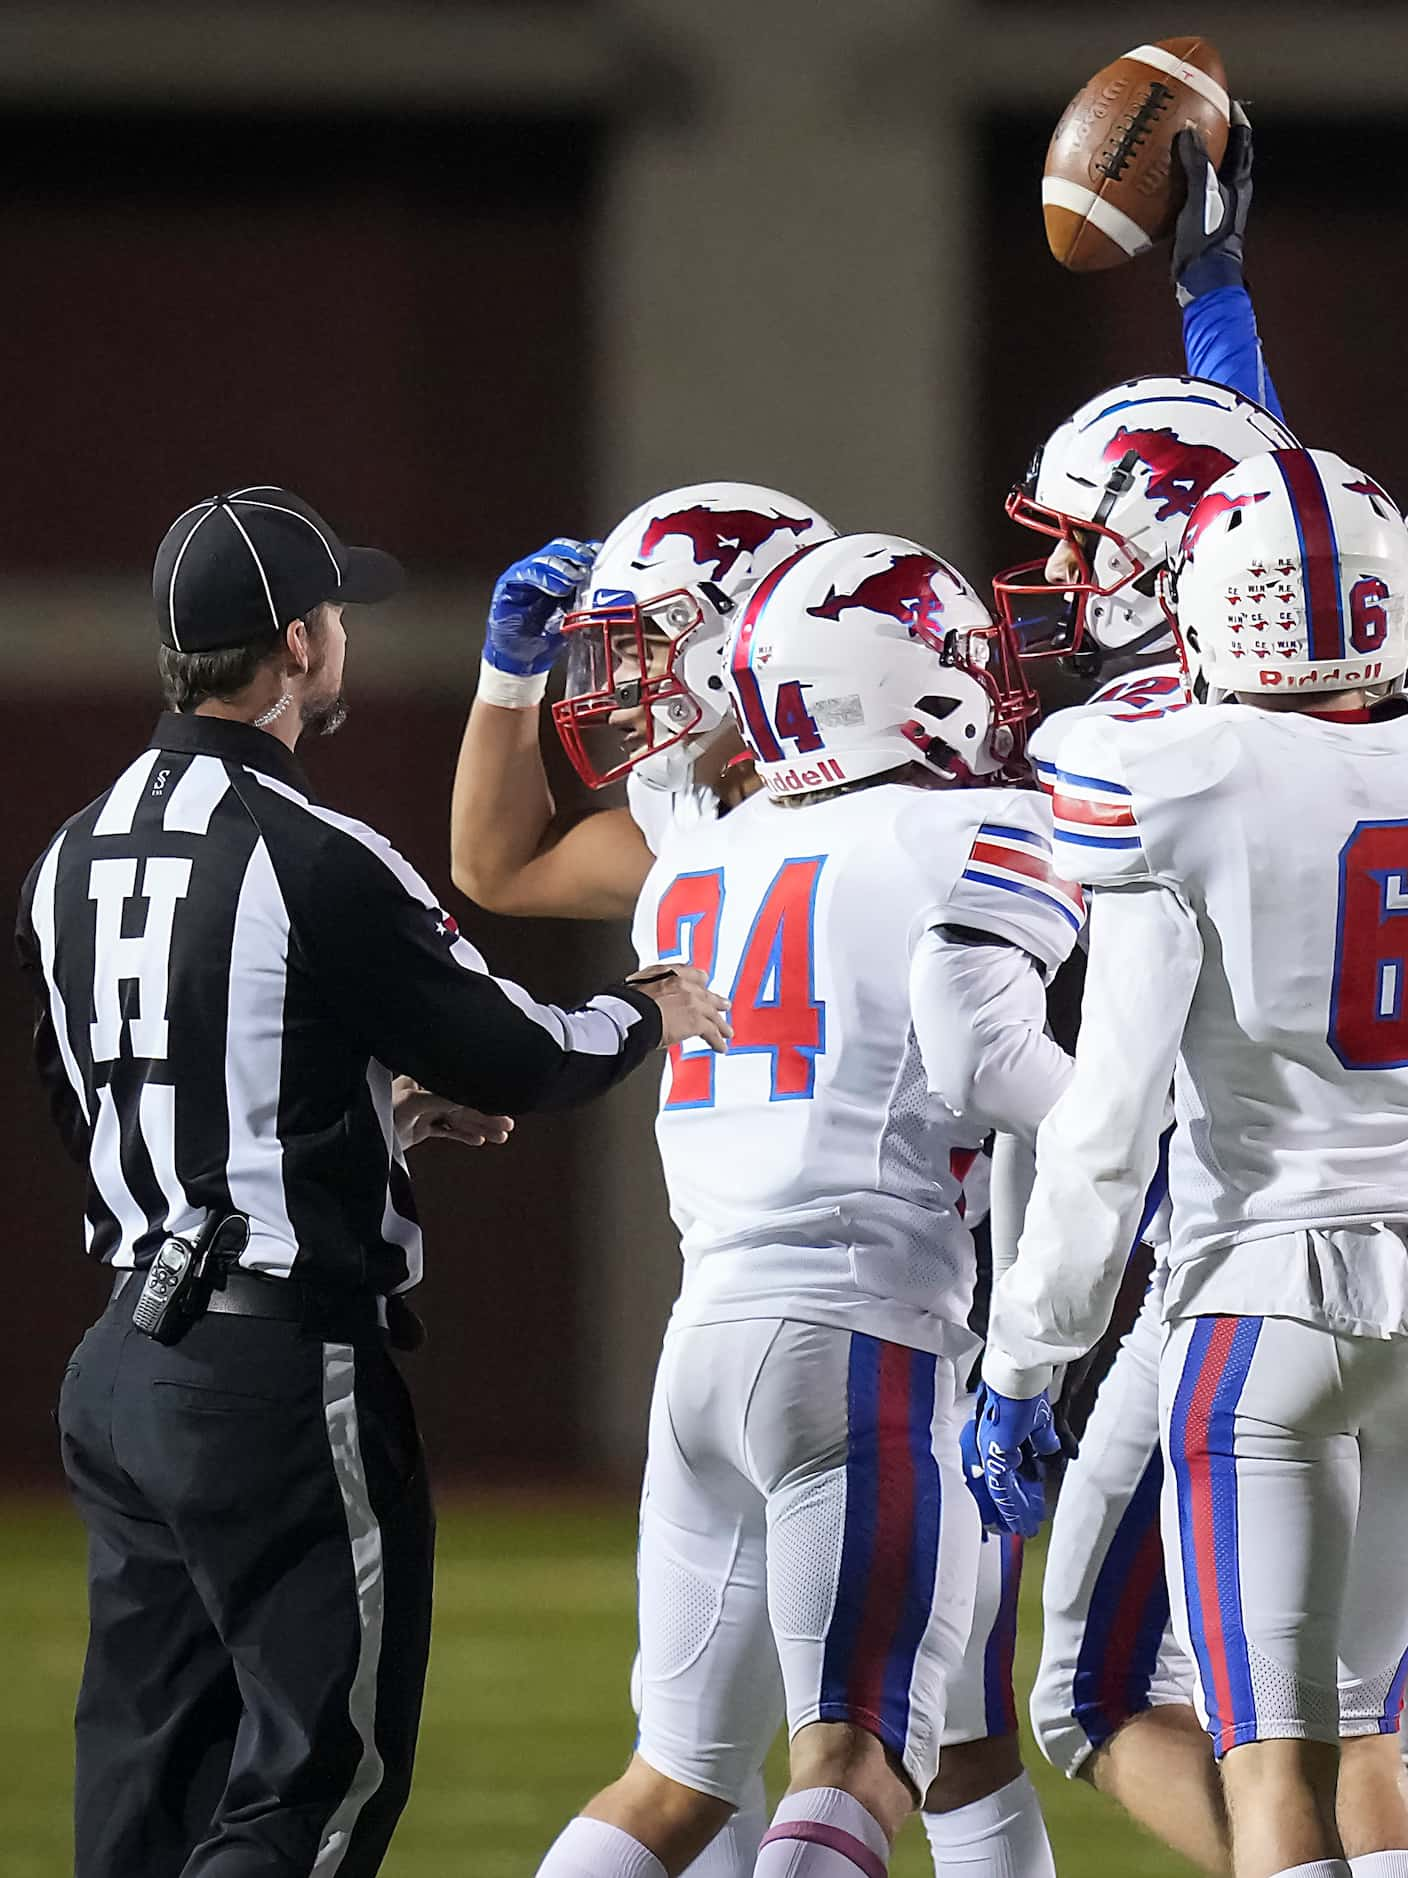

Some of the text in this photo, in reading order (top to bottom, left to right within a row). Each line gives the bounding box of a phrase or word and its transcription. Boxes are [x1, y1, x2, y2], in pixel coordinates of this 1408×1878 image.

[1349, 576, 1390, 654] 6
[1259, 662, 1382, 686] Riddell
[87, 856, 194, 1063] H
[656, 853, 829, 1112] 24
[987, 1441, 1020, 1521] VAPOR
